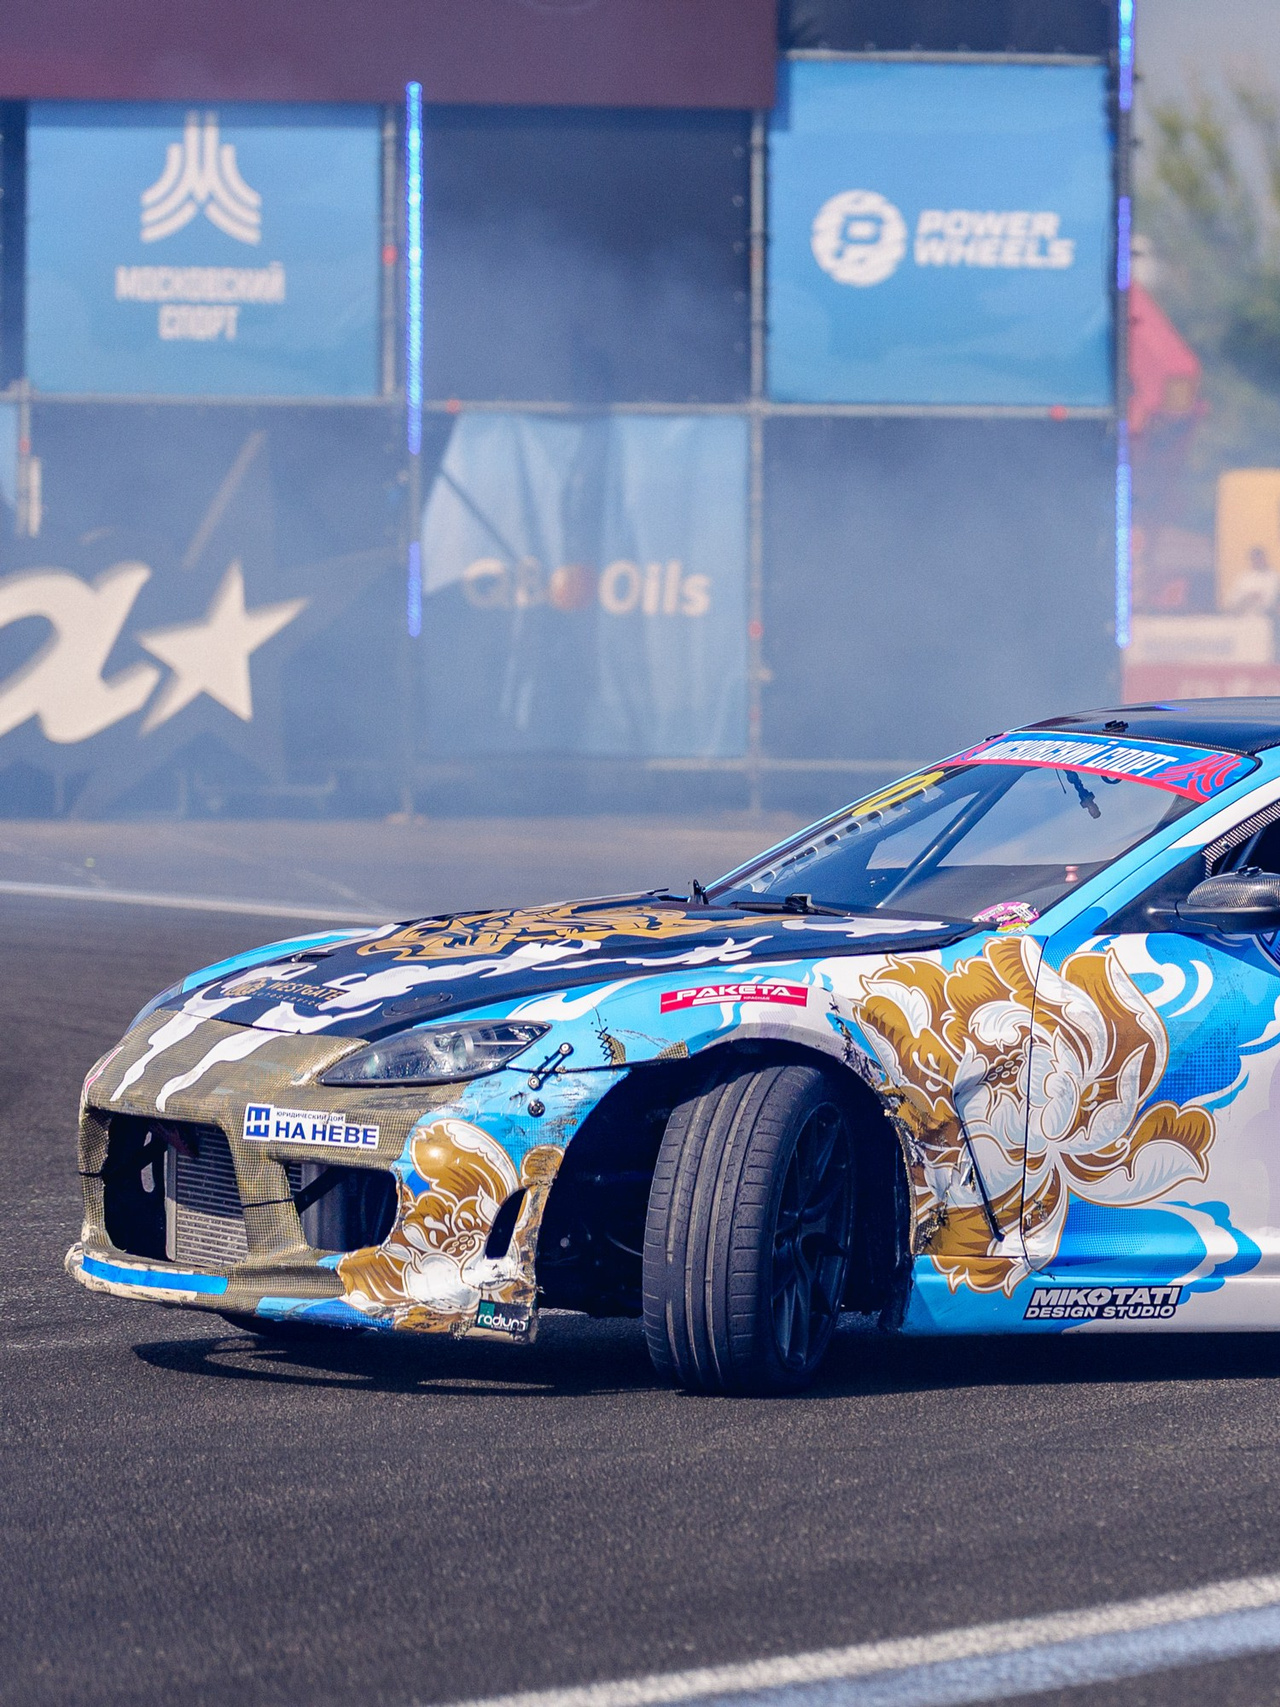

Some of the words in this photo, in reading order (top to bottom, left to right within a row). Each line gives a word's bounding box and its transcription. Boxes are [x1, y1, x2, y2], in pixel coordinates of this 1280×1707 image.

[916, 209, 1060, 238] POWER
[914, 239, 1075, 269] WHEELS
[275, 1121, 306, 1140] НА
[311, 1123, 377, 1145] НЕВЕ
[1030, 1287, 1180, 1306] MIKOTATI
[1025, 1306, 1097, 1318] DESIGN
[1103, 1305, 1174, 1317] STUDIO
